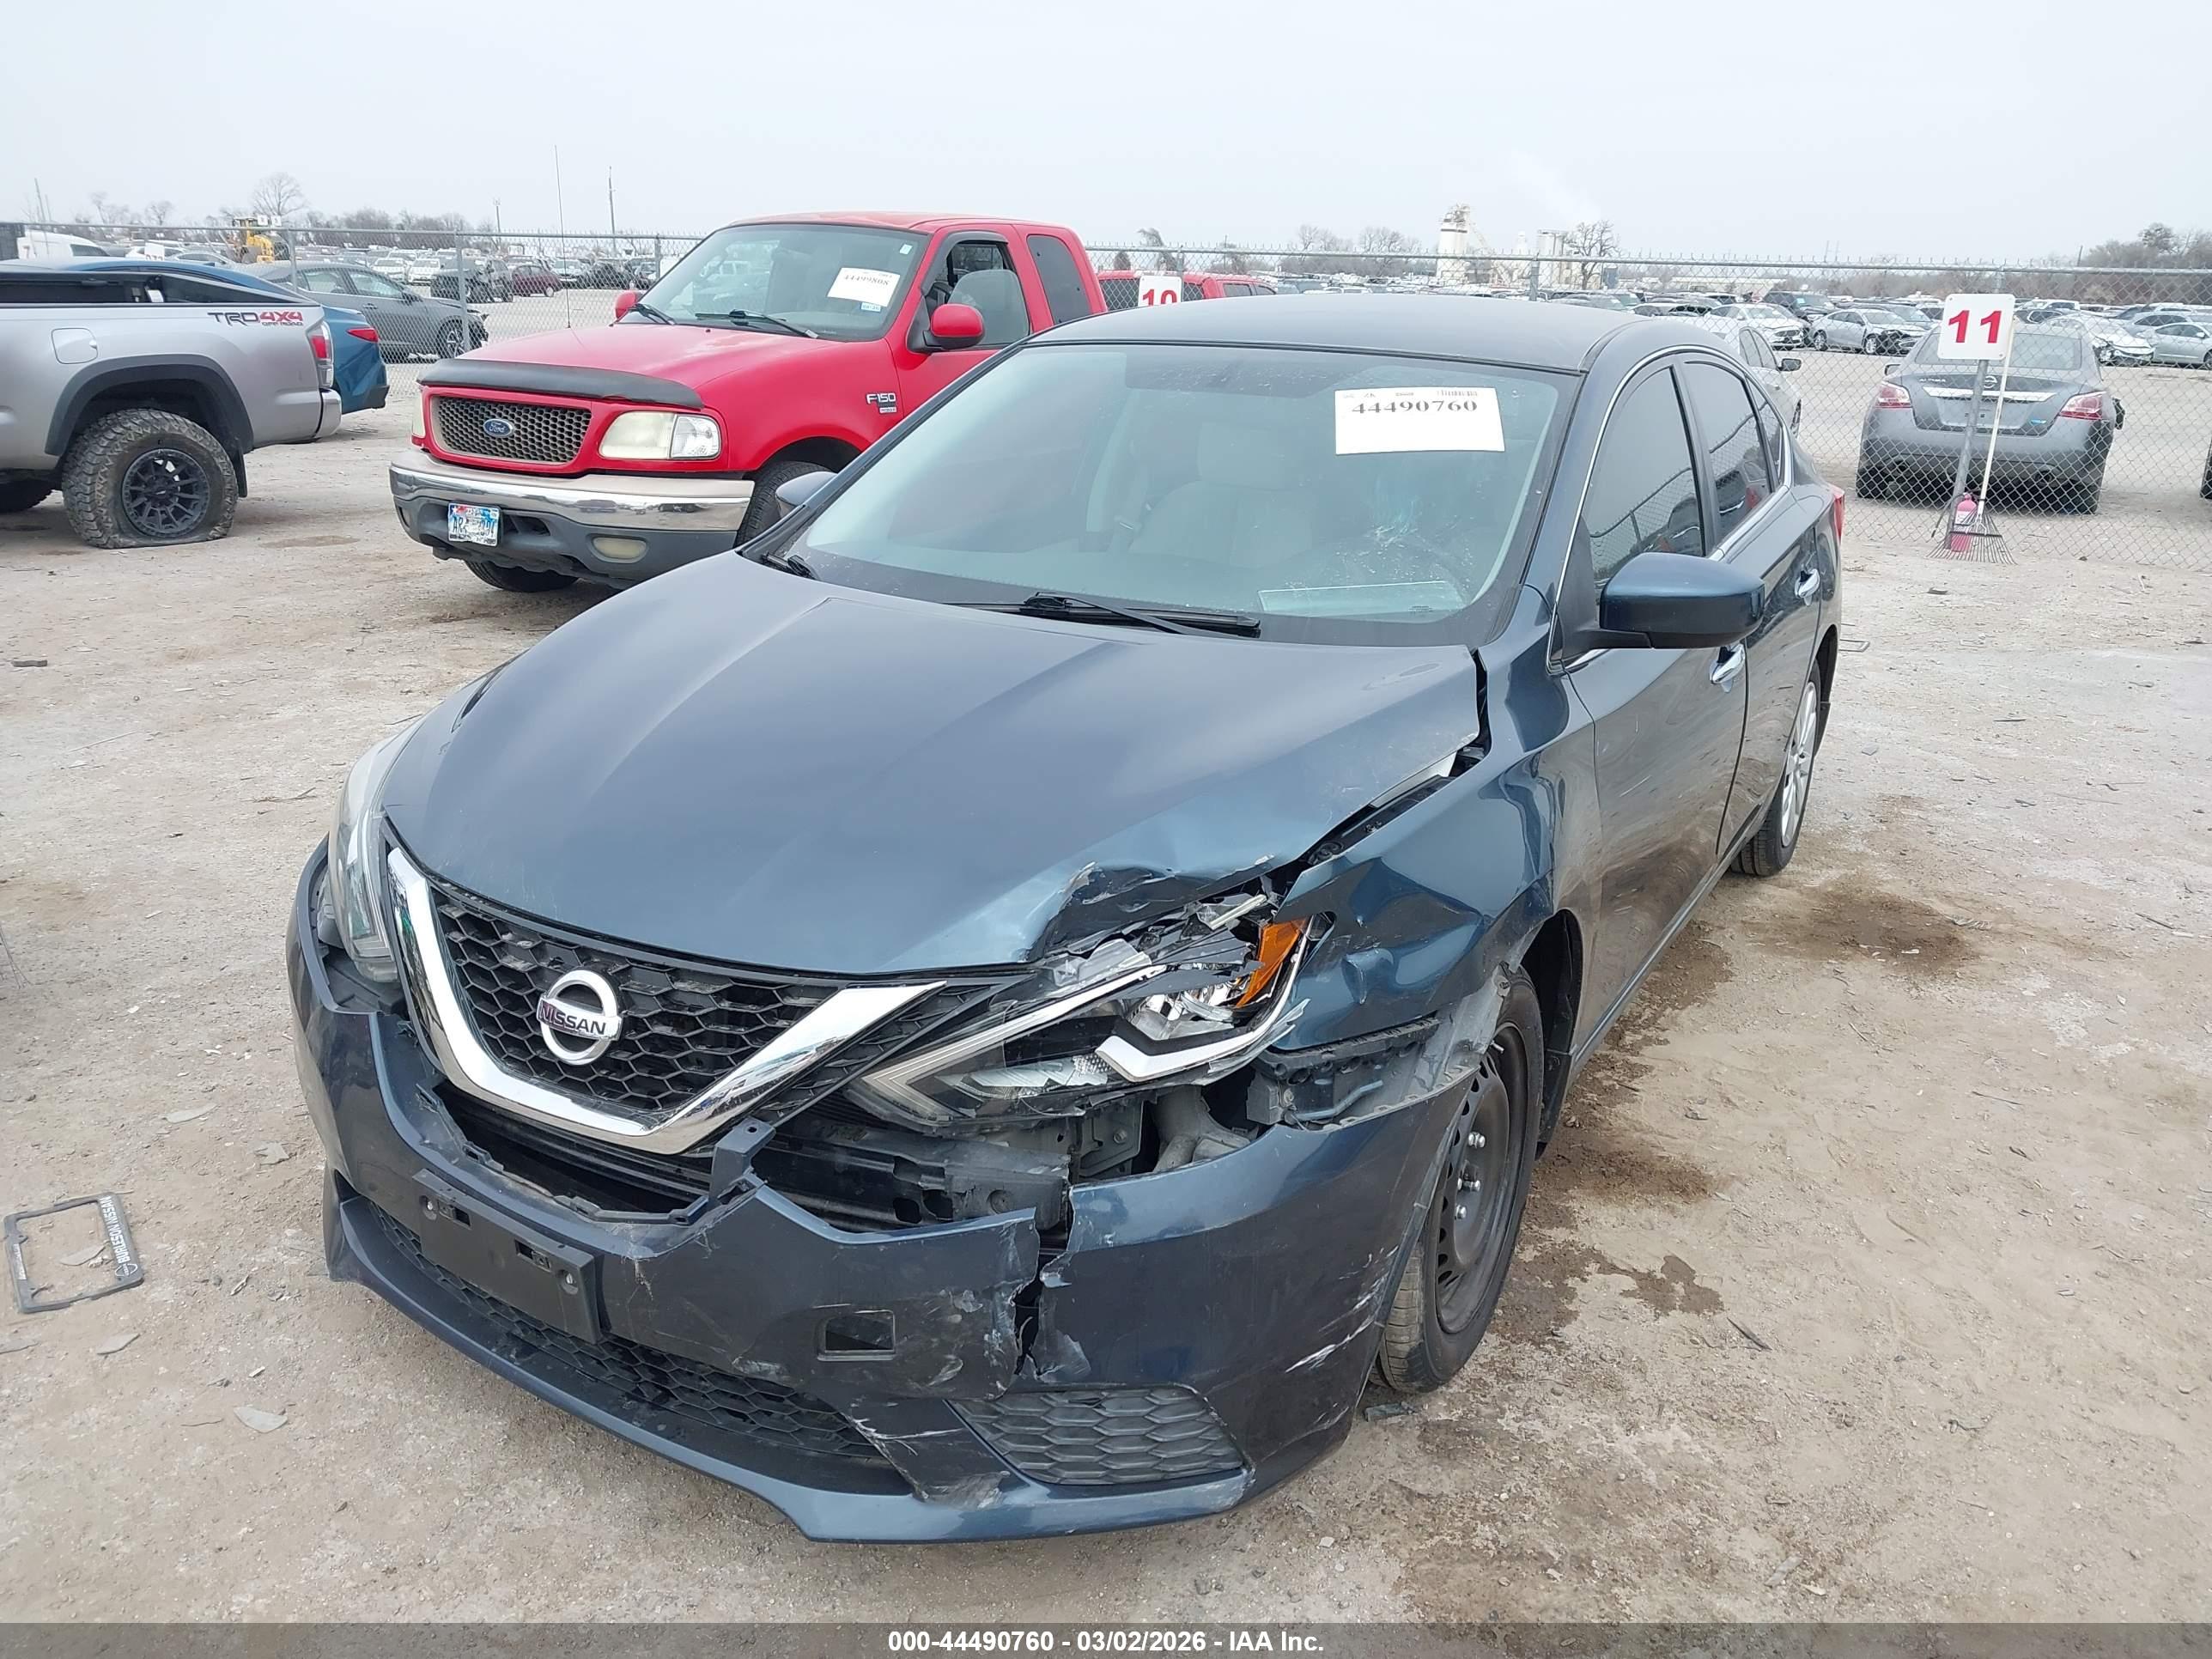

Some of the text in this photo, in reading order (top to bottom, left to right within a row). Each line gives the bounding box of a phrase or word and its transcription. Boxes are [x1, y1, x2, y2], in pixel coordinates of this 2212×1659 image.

[207, 312, 259, 326] TRD
[1948, 310, 2002, 343] 11
[1352, 400, 1477, 414] 44490760
[489, 422, 506, 433] Ford
[539, 1003, 606, 1035] NISSAN
[100, 1195, 131, 1264] BURLESON NISSAN
